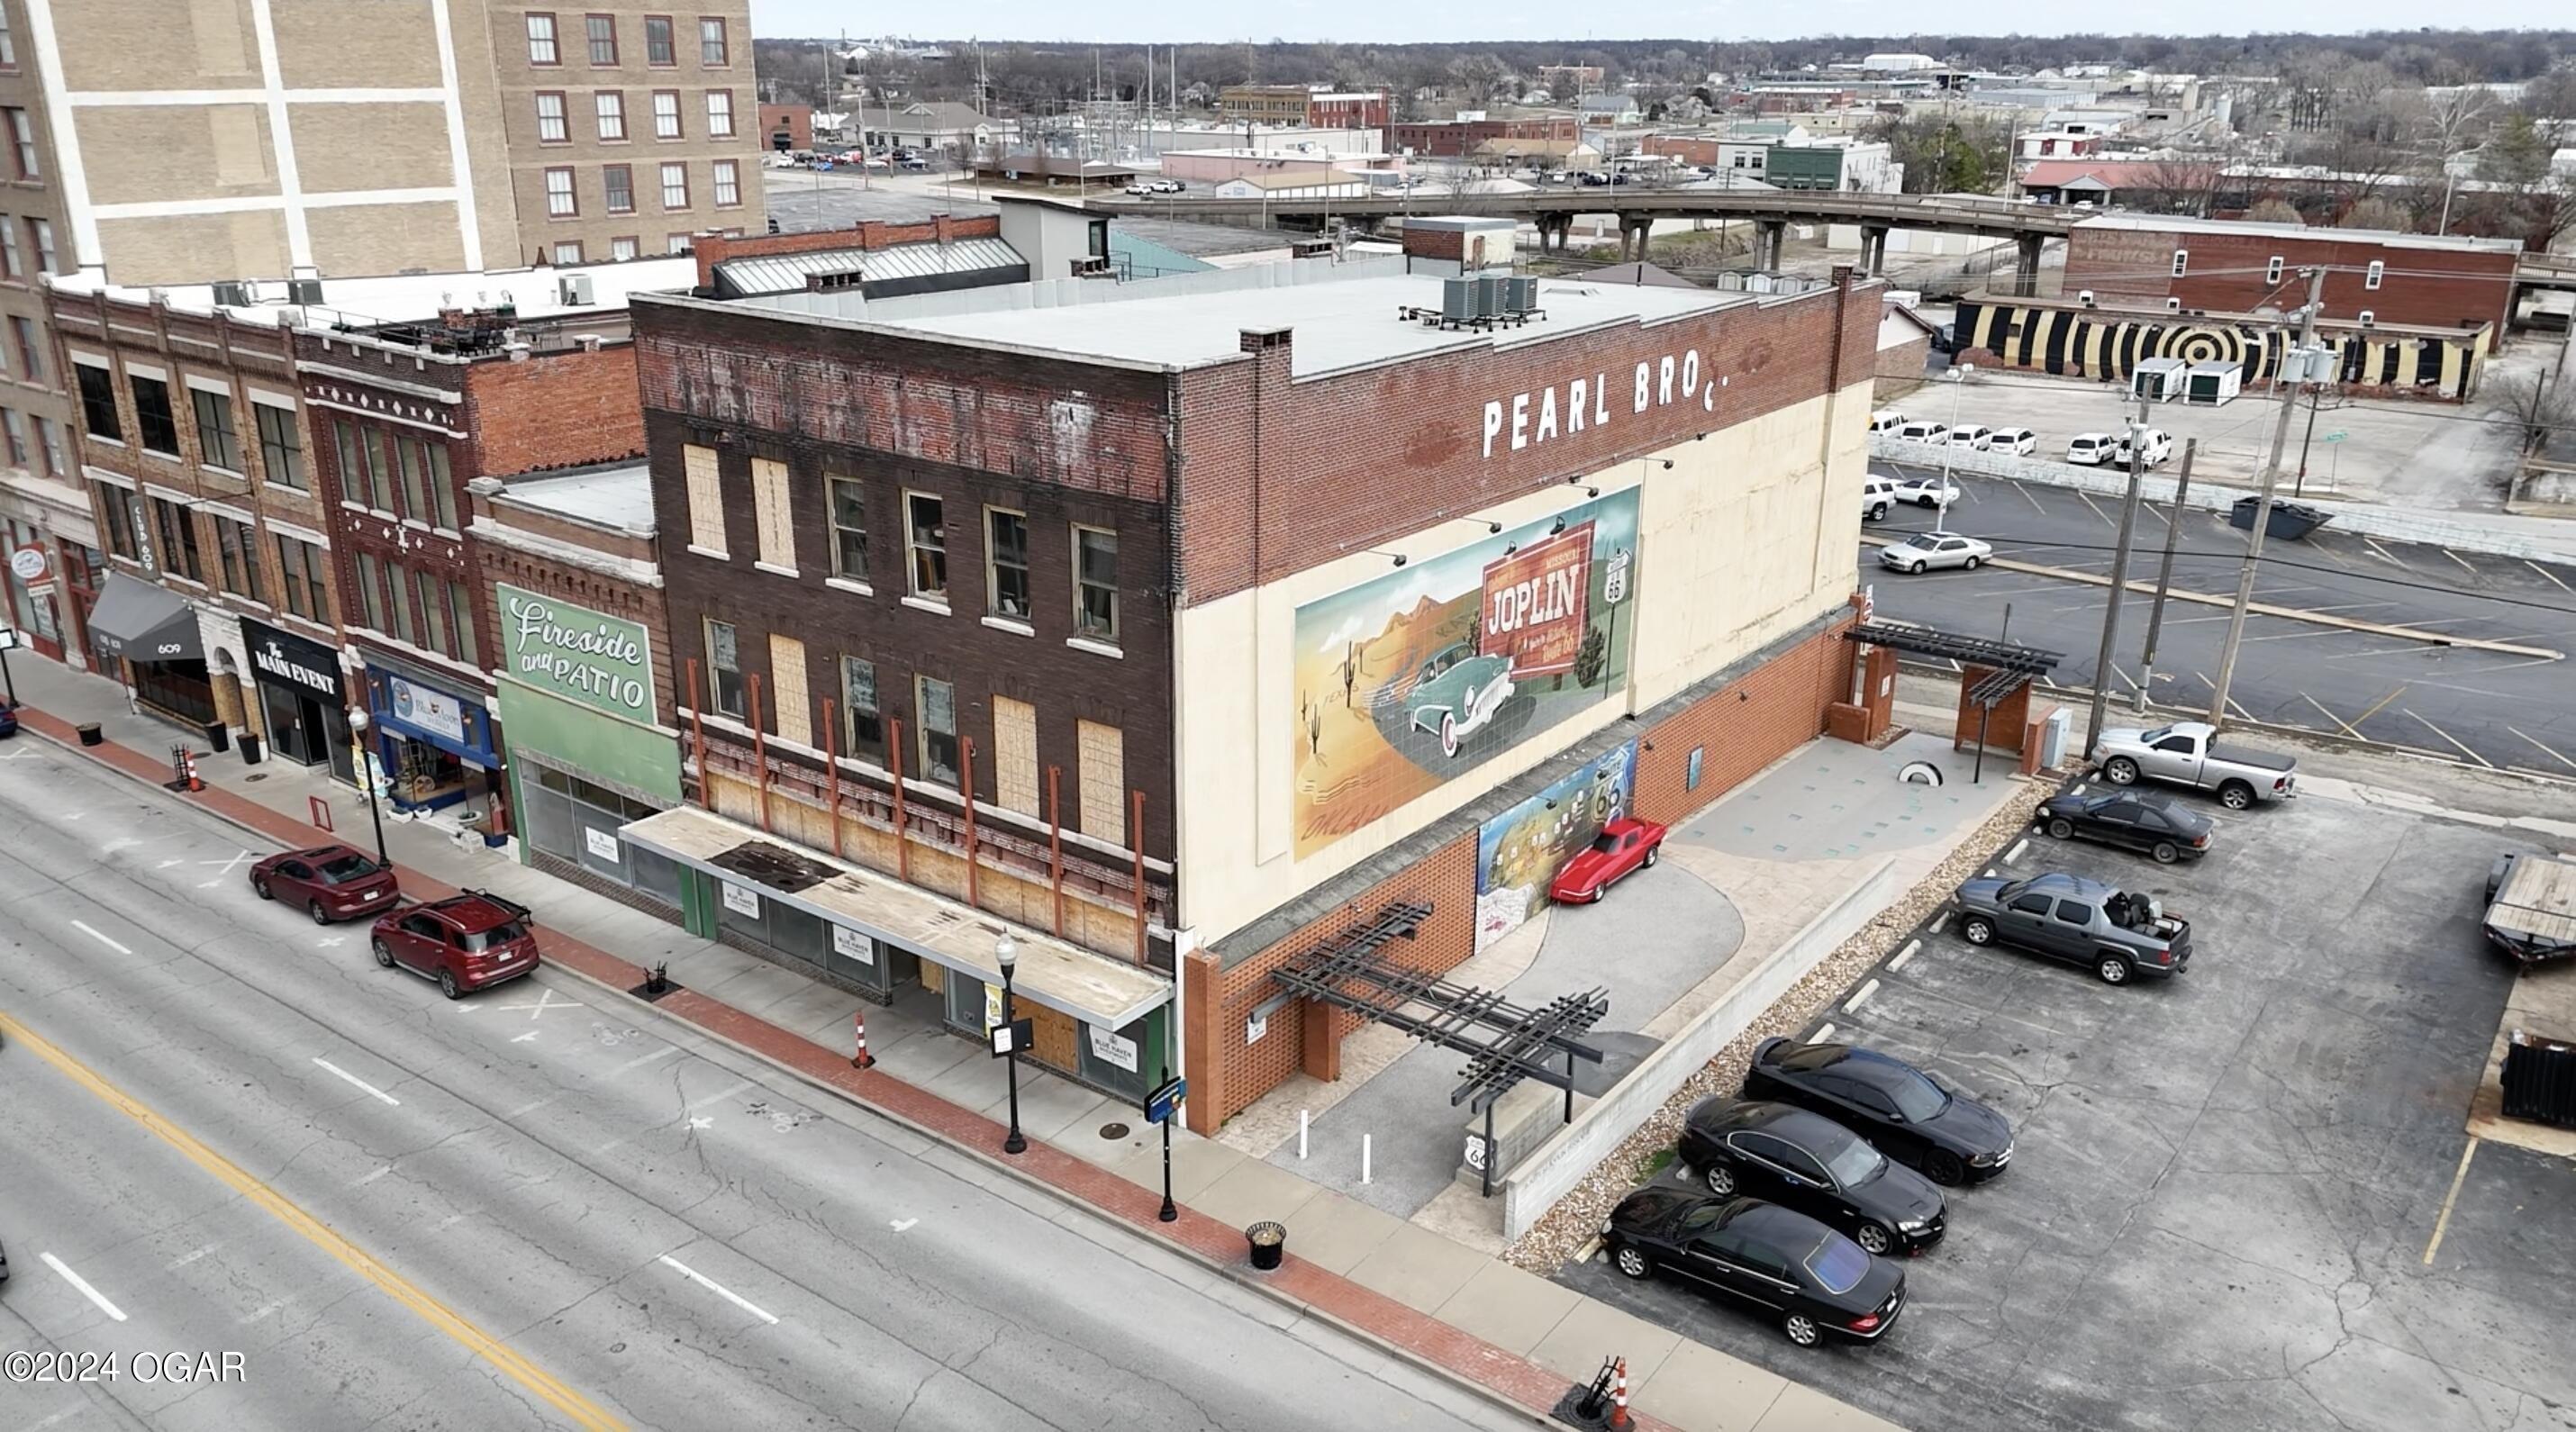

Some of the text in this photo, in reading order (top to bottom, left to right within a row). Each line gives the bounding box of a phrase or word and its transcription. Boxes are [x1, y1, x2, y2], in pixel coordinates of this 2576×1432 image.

[1483, 373, 1610, 458] PEARL
[141, 545, 152, 570] 609
[1488, 564, 1580, 636] JOPLIN
[1609, 580, 1620, 599] 66
[158, 644, 181, 654] 609
[510, 597, 641, 665] Fireside
[255, 651, 335, 694] MAIN EVENT
[522, 651, 644, 708] and PATIO
[1596, 779, 1620, 814] 66
[1094, 1038, 1132, 1058] BLUE HAVEN
